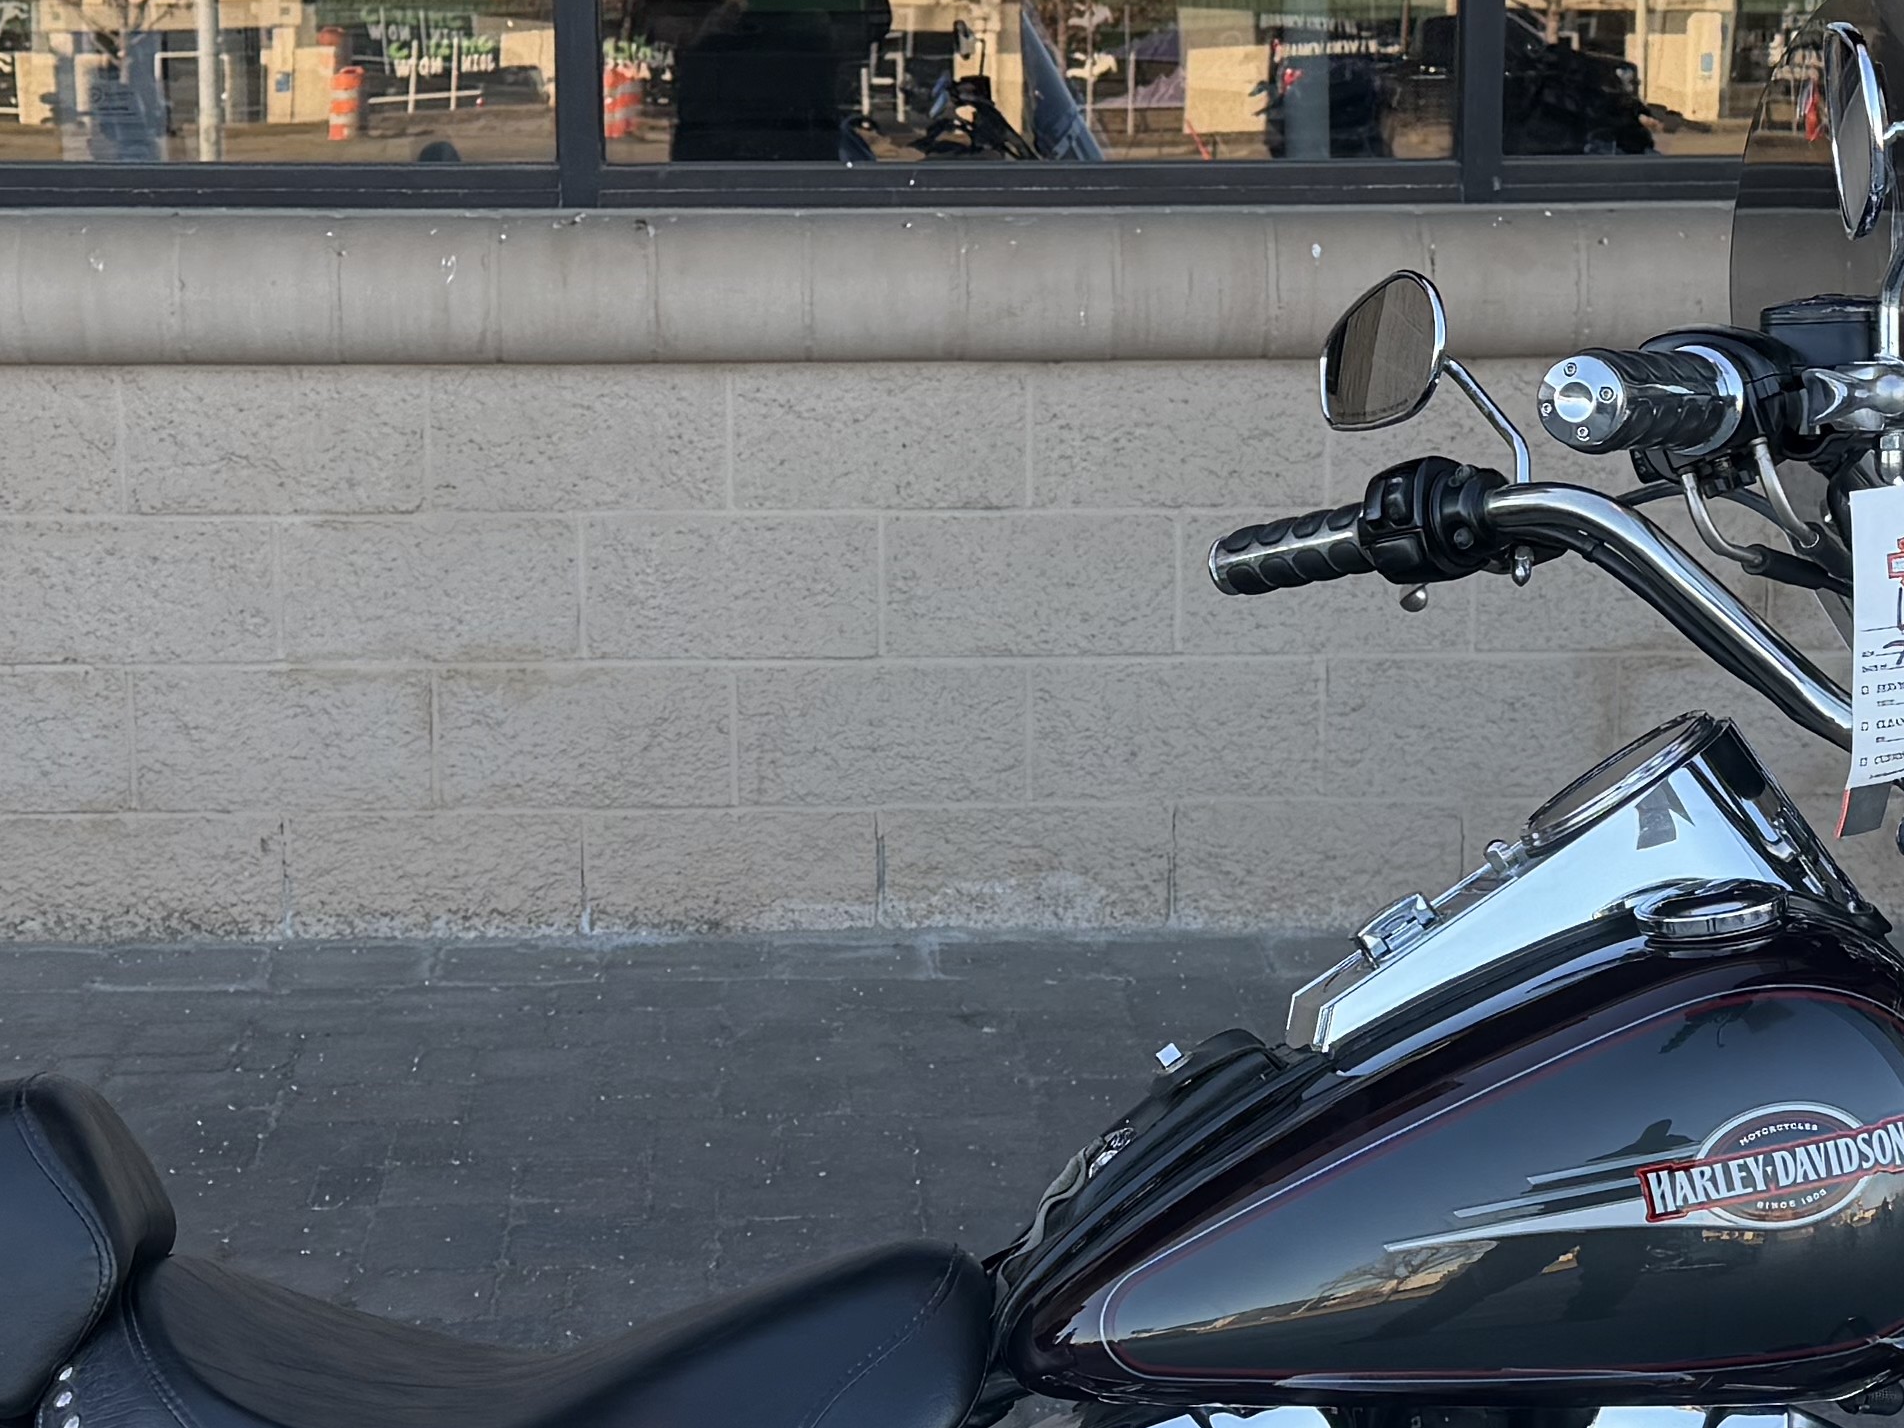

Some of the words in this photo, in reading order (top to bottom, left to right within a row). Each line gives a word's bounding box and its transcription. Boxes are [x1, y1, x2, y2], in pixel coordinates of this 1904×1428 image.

[1739, 1123, 1818, 1146] MOTORCYCLES
[1756, 1199, 1796, 1210] SINCE
[1801, 1189, 1827, 1206] 1903
